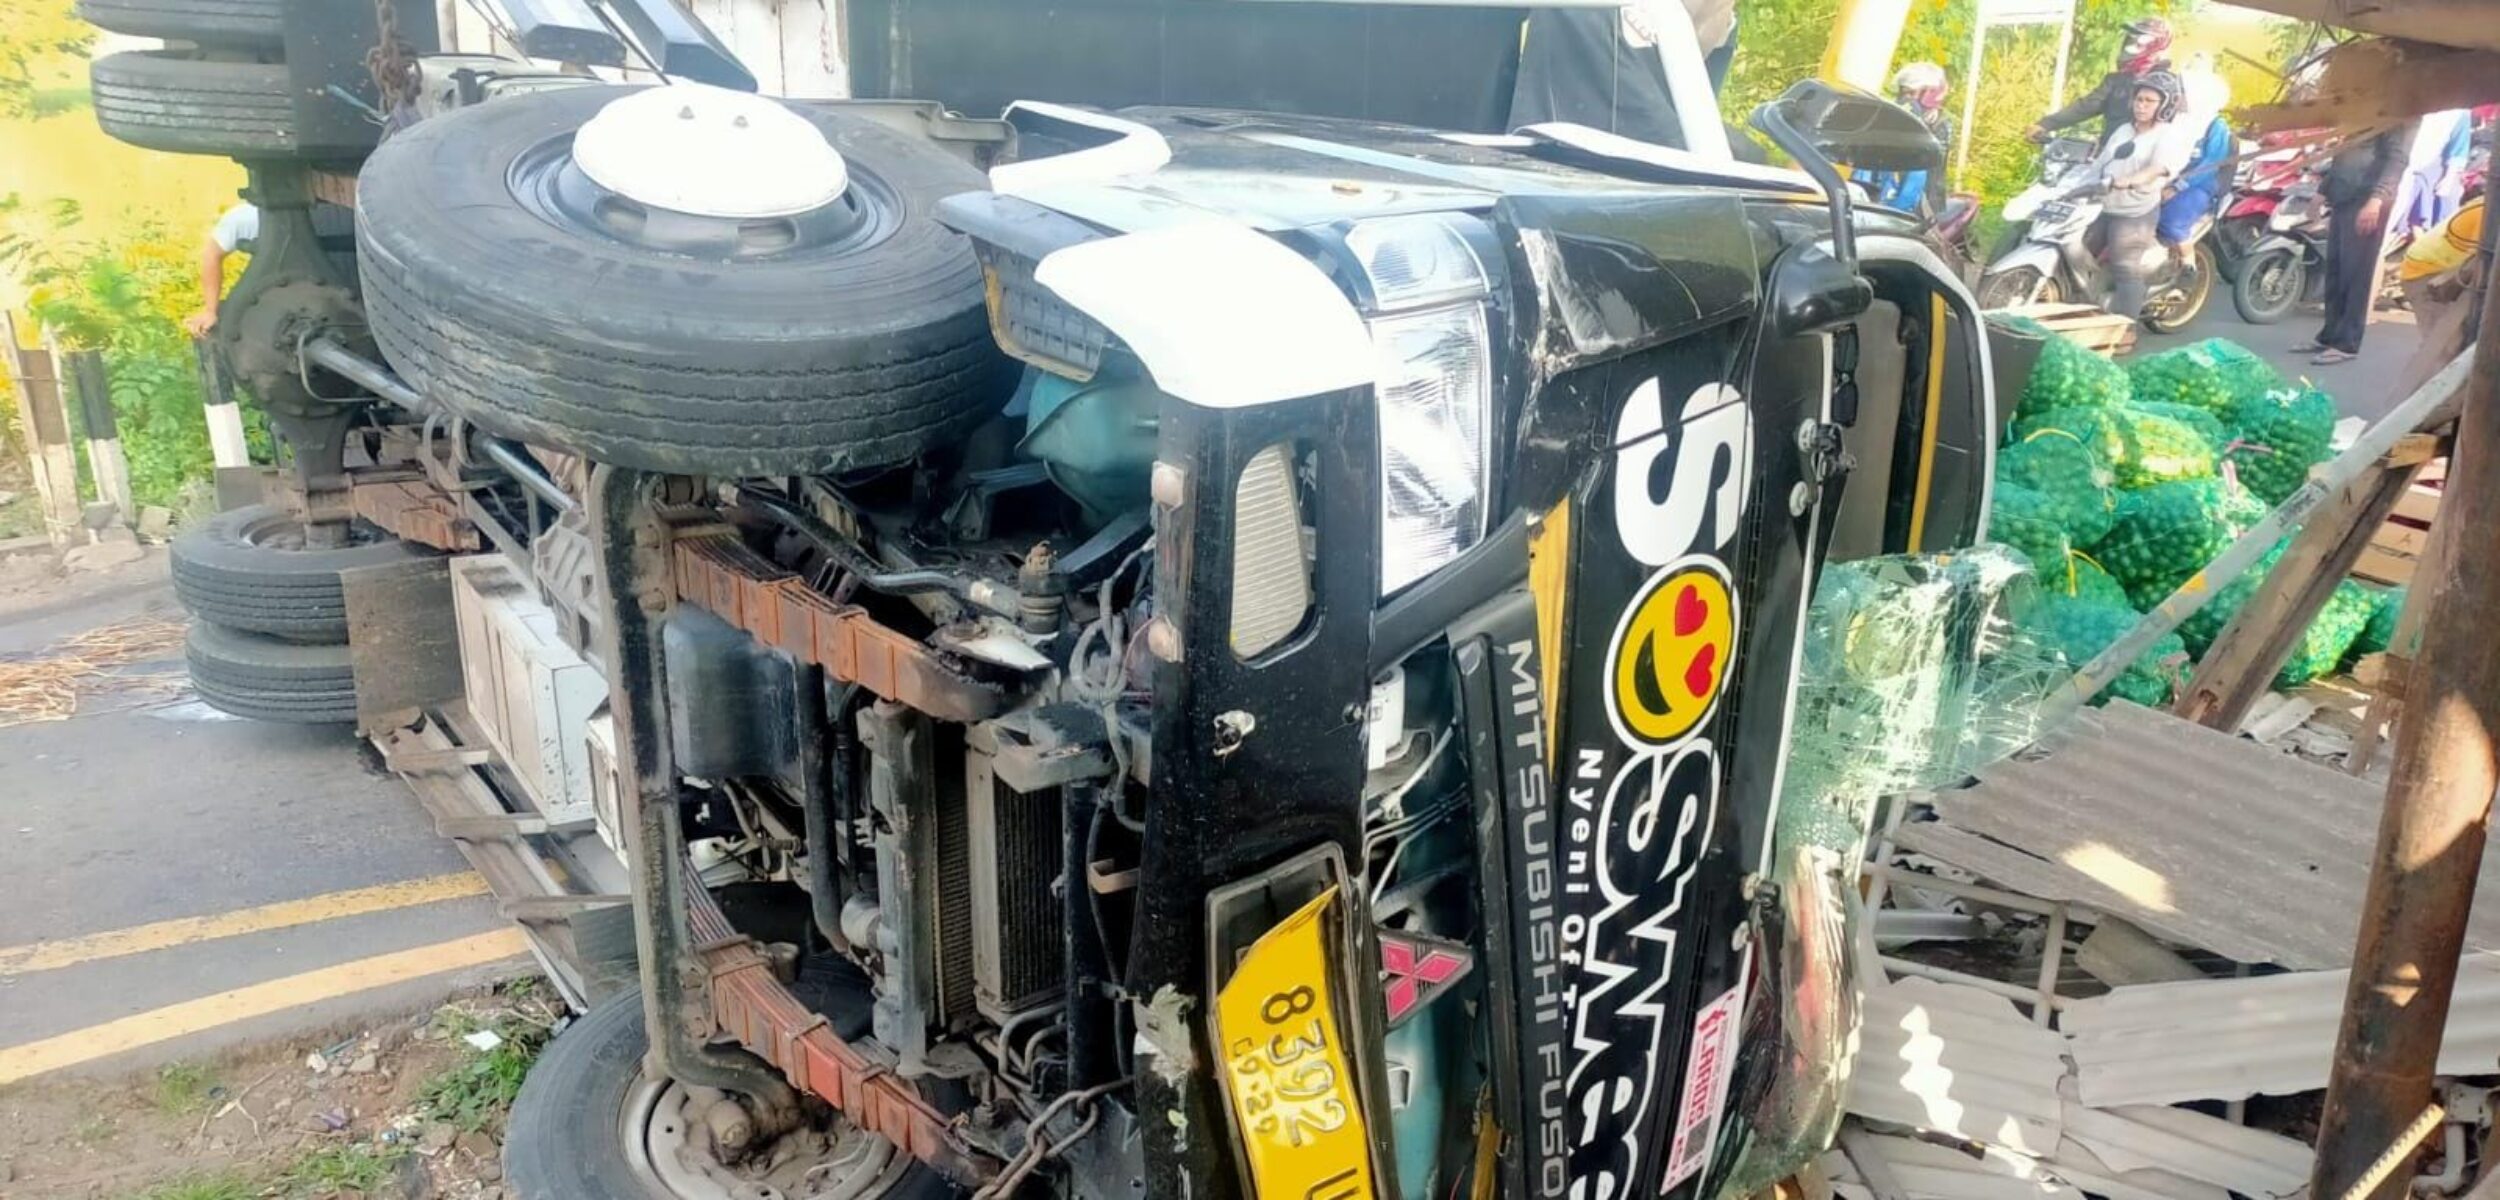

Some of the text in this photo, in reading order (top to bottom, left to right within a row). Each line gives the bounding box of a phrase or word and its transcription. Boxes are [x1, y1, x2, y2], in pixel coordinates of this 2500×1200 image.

[1566, 749, 1604, 893] Nyeni
[1508, 639, 1567, 1199] MITSUBISHI FUSO
[1560, 914, 1586, 966] Of
[1261, 985, 1347, 1148] 8392
